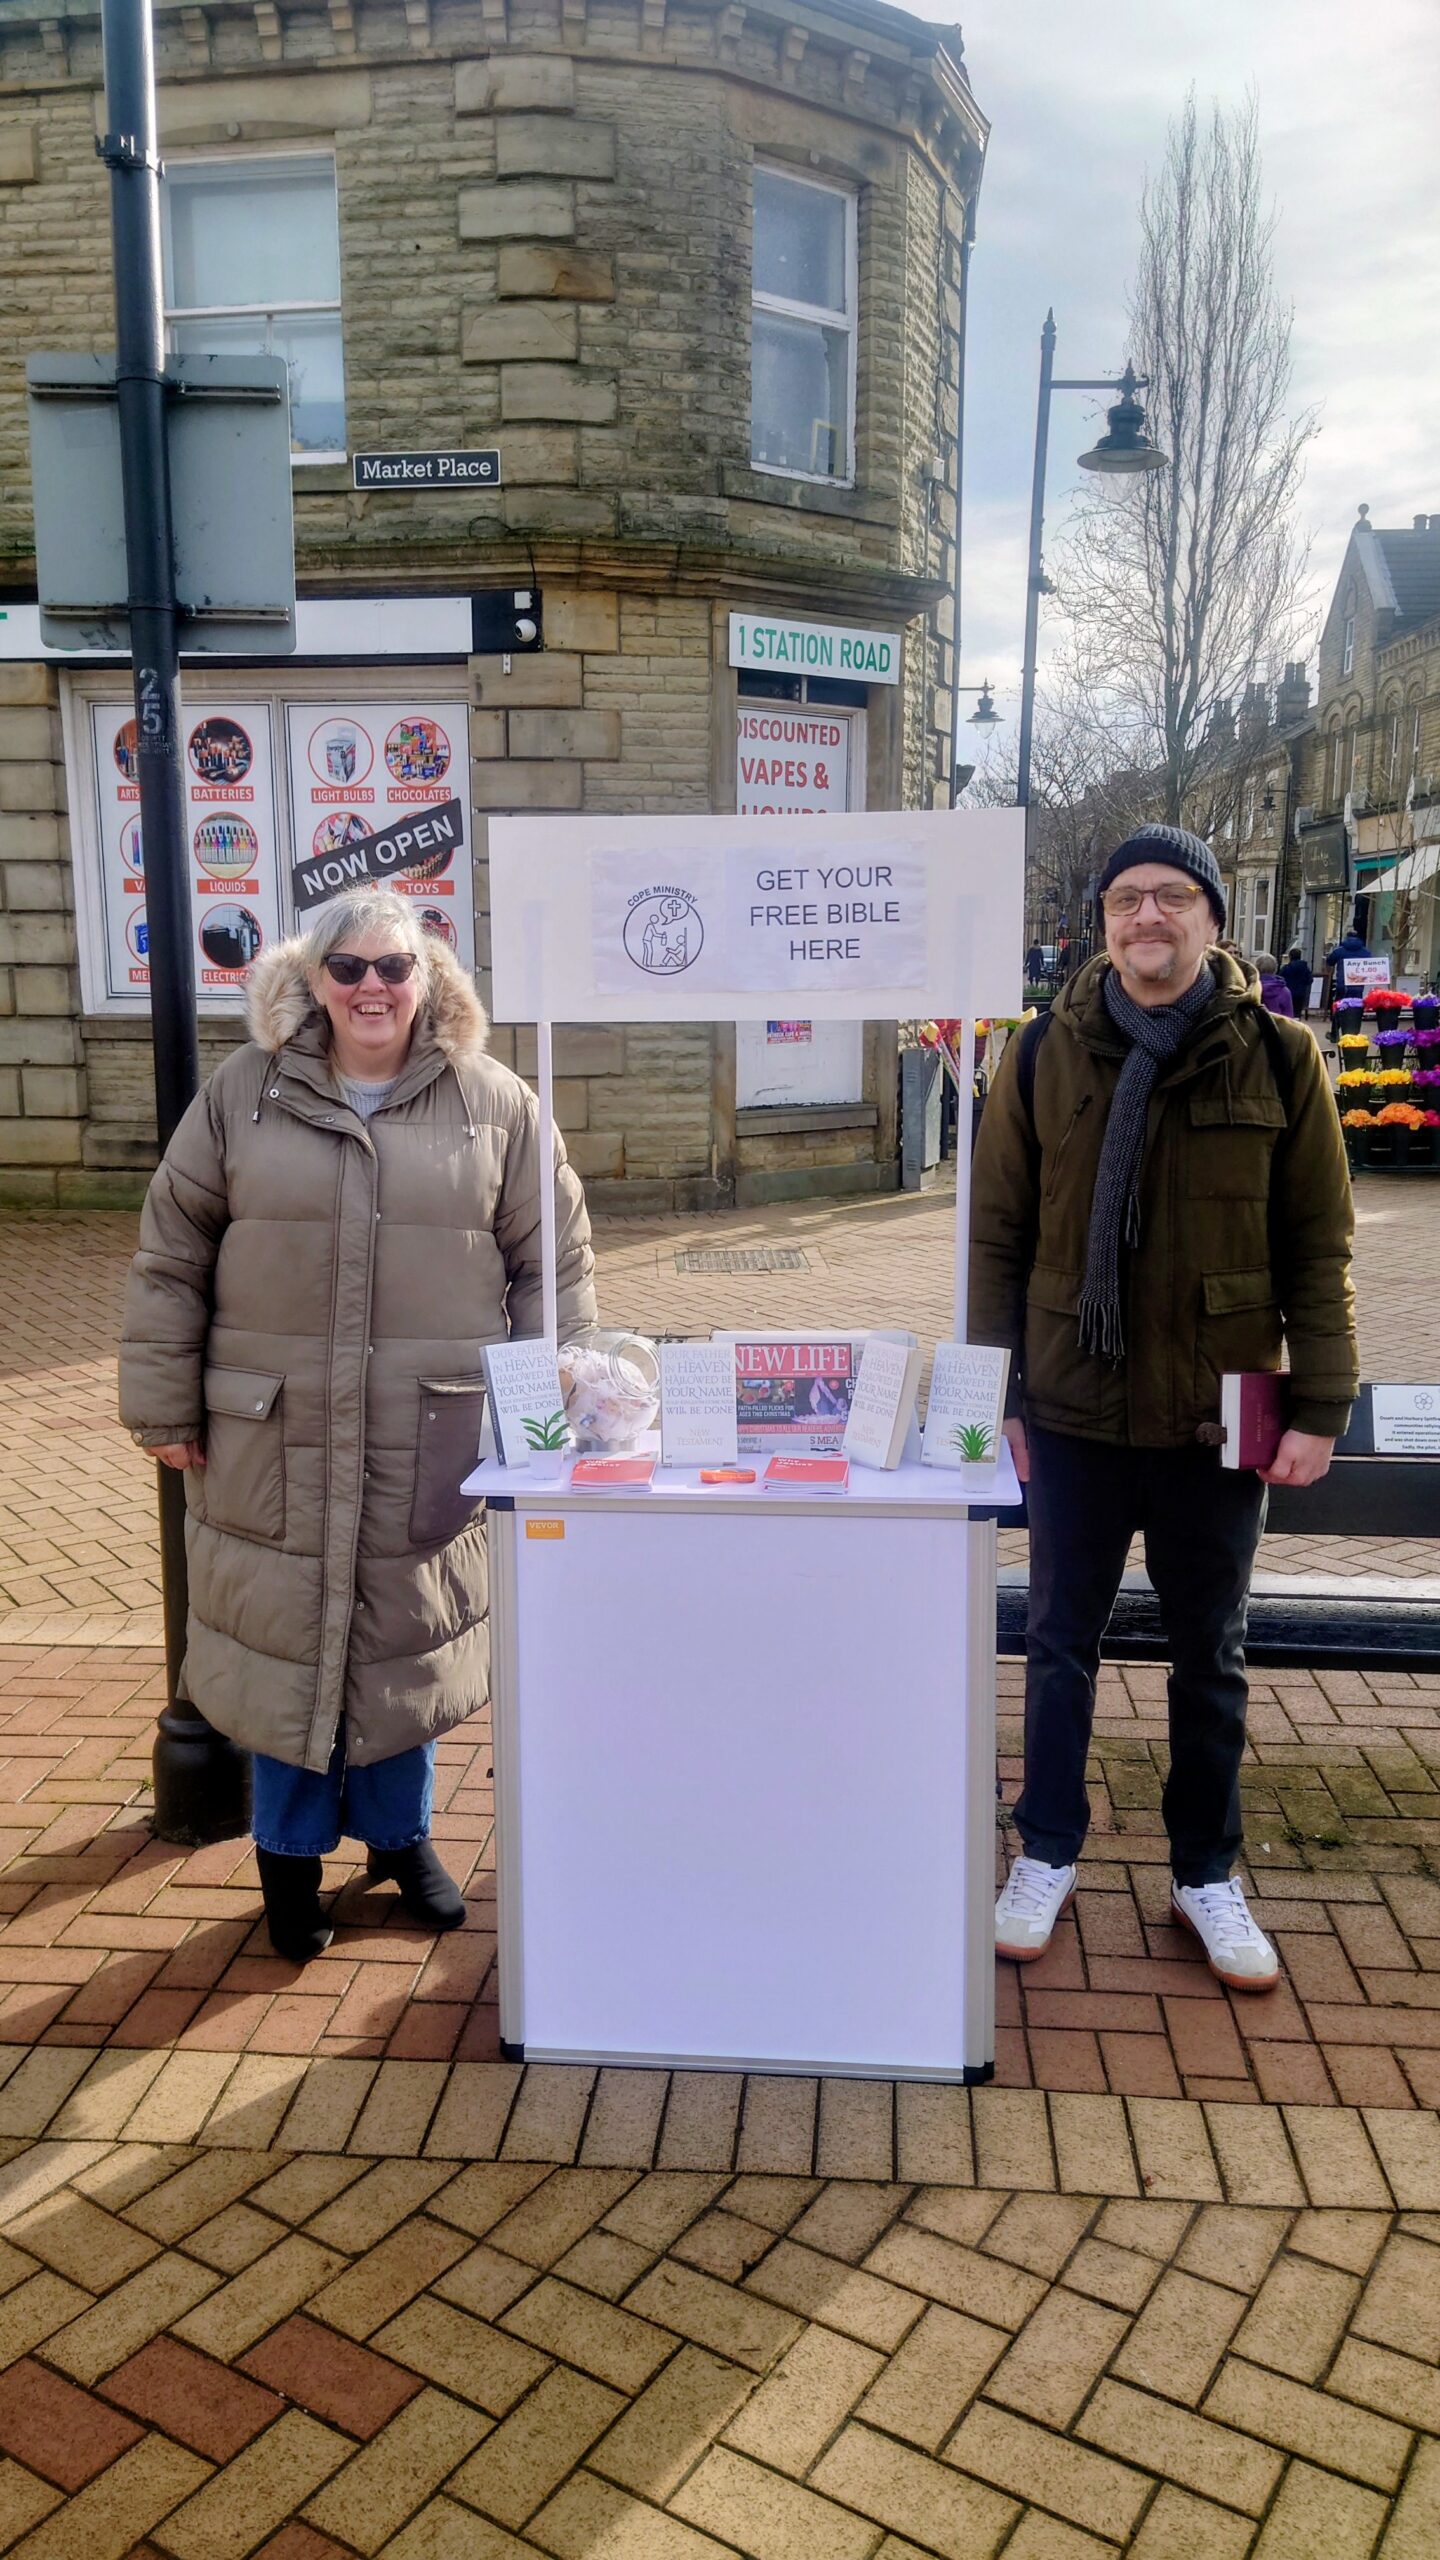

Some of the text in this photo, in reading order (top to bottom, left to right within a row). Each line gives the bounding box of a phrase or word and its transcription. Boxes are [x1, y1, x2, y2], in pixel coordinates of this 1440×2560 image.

[362, 458, 492, 479] Market Place
[738, 625, 891, 673] 1 STATION ROAD
[740, 757, 830, 790] VAPES &
[193, 788, 252, 800] BATTERIES
[313, 790, 374, 801] LIGHT BULBS
[388, 790, 451, 801] CHOCOLATES
[302, 815, 455, 896] NOW OPEN
[756, 866, 893, 891] GET YOUR
[209, 881, 246, 893] LIQUIDS
[405, 882, 440, 894] TOYS
[627, 886, 698, 907] COPE MINISTRY
[750, 901, 900, 927] FREE BIBLE
[790, 938, 861, 961] HERE
[735, 1345, 849, 1372] NEW LIFE
[721, 1375, 733, 1385] BE
[987, 1380, 999, 1390] BE
[496, 1384, 531, 1398] YOUR
[665, 1386, 701, 1400] YOUR
[933, 1385, 965, 1401] YOUR
[522, 1402, 533, 1412] BE
[690, 1406, 702, 1415] BE
[952, 1408, 965, 1417] BE
[529, 1521, 560, 1529] VEVOR
